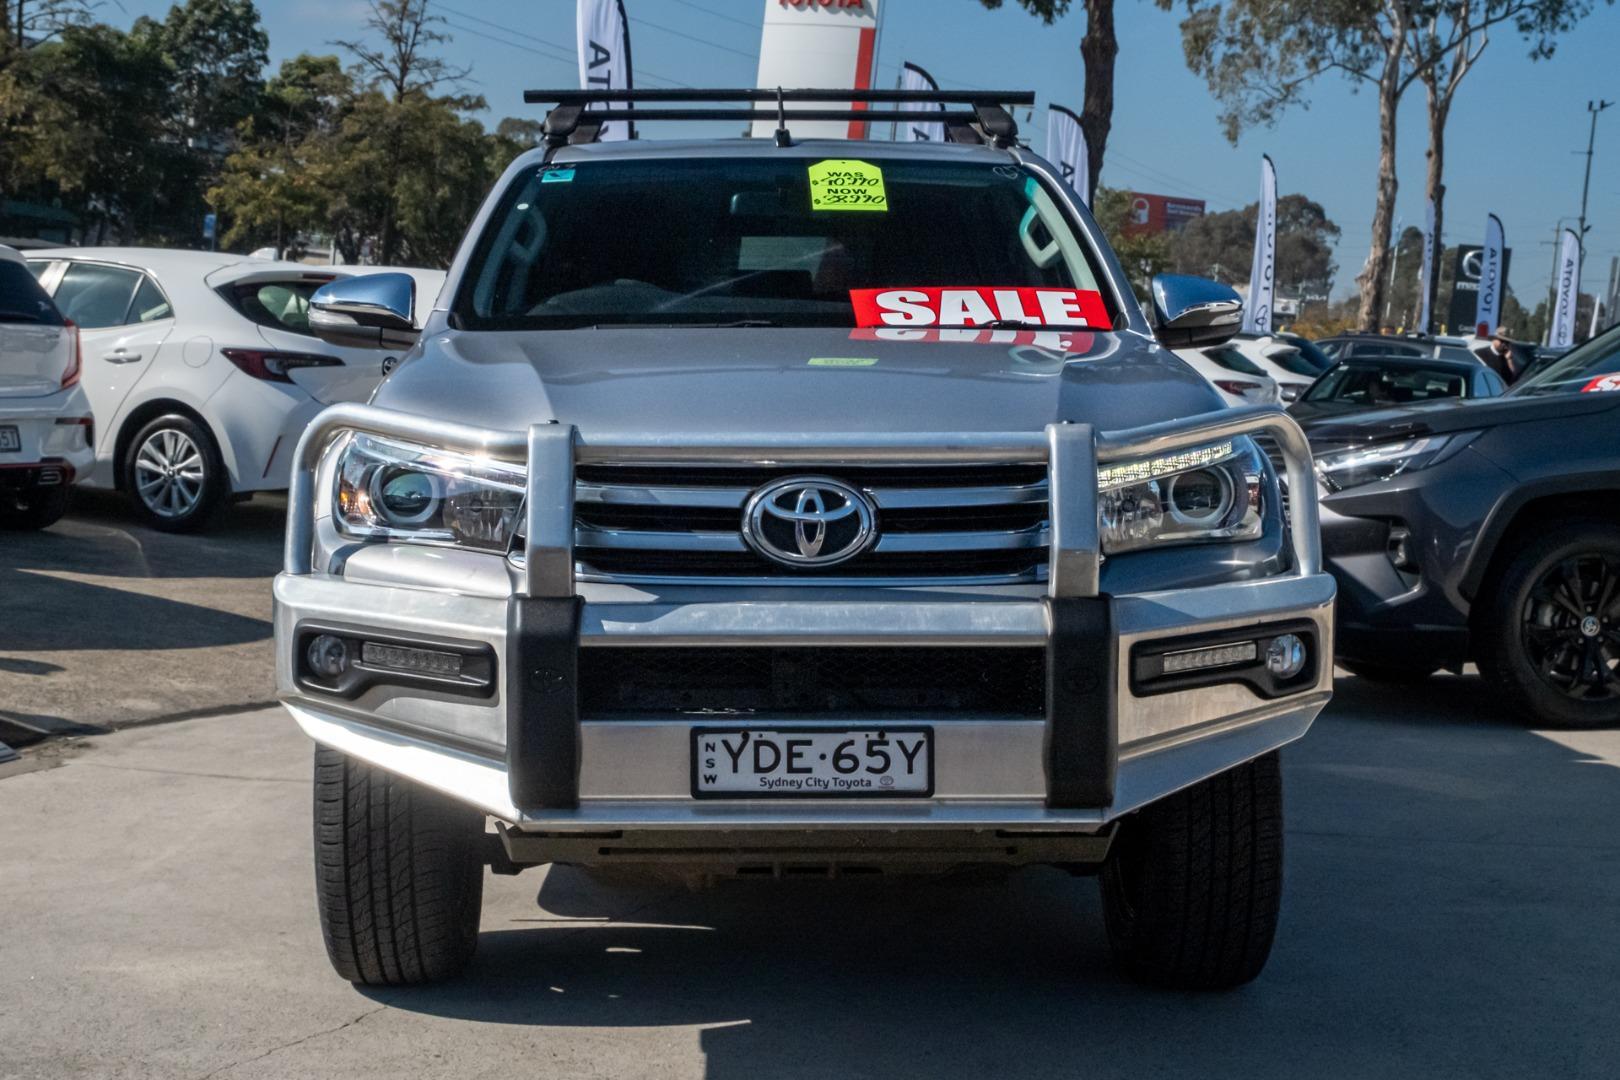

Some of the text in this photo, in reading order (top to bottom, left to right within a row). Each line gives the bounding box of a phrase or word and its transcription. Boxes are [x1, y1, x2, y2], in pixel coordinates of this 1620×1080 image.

[875, 290, 1088, 326] SALE
[703, 742, 718, 784] NSW
[759, 776, 872, 790] Sydney City Toyota
